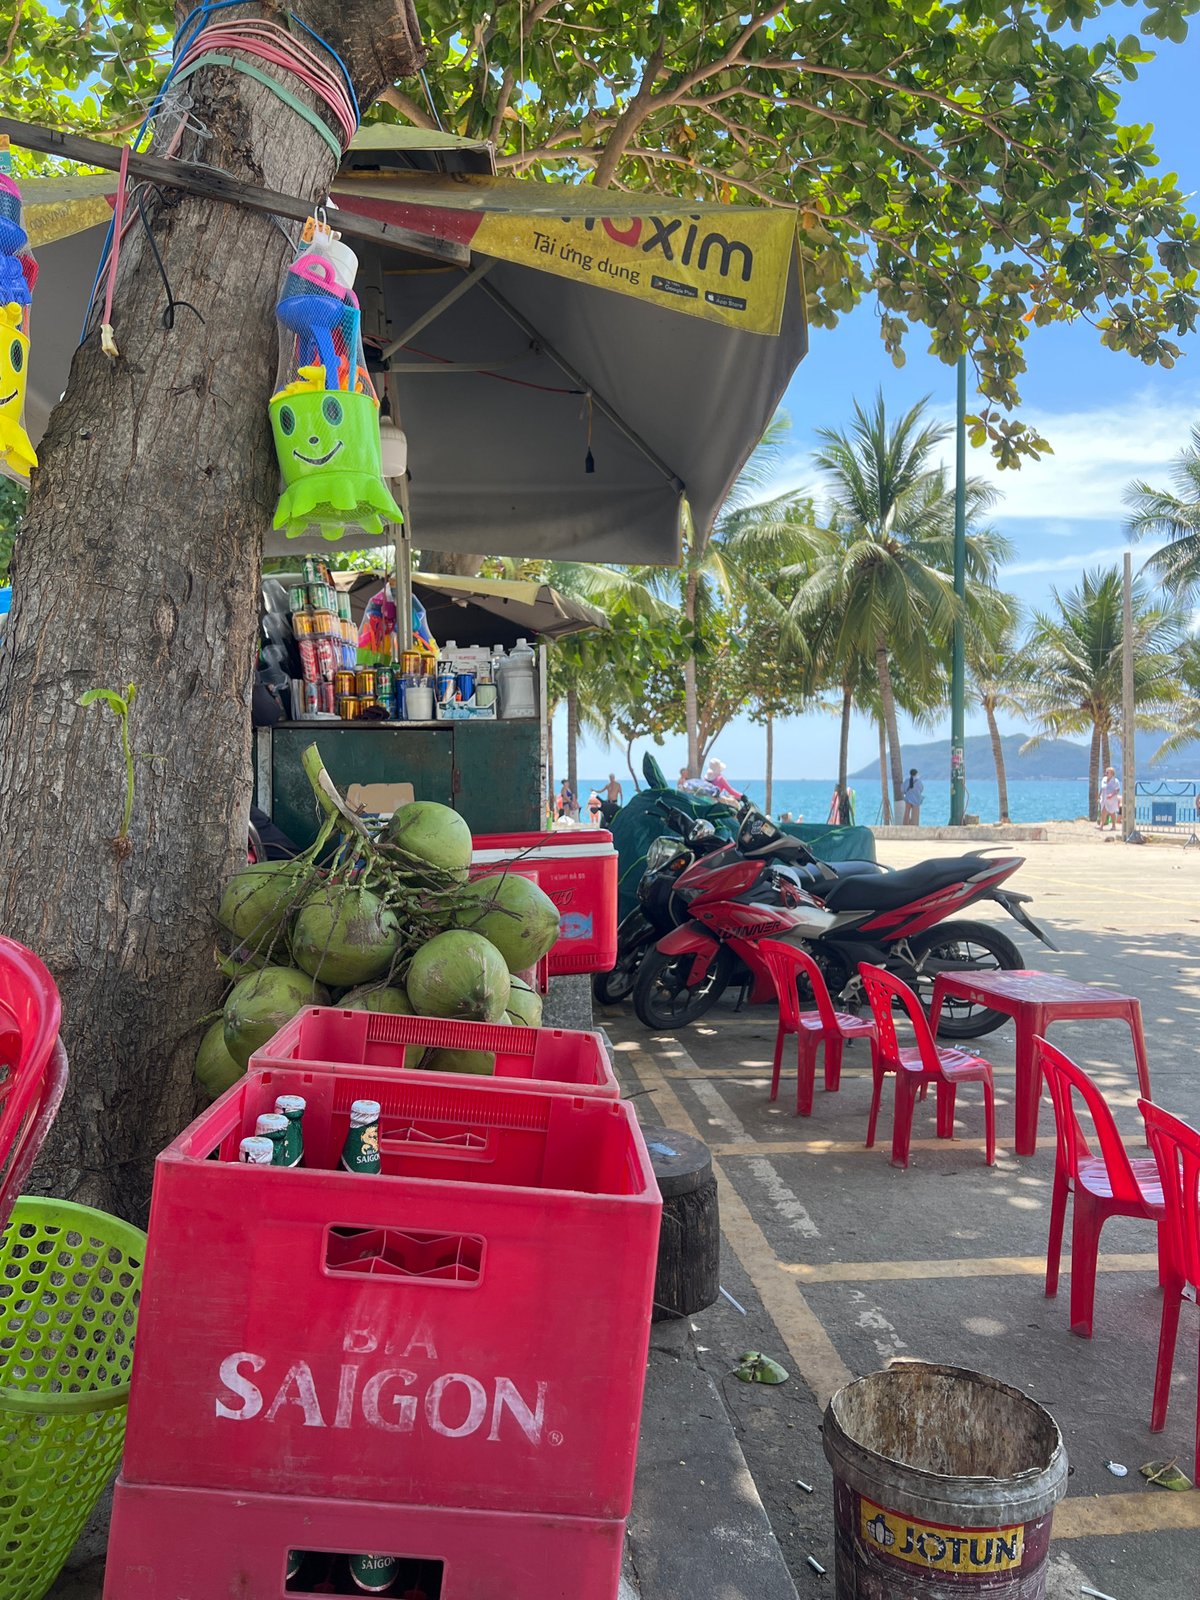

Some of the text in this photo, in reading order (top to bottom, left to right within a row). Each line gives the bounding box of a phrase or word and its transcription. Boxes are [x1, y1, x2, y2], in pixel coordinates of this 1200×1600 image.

[533, 231, 641, 285] Tải ứng dụng
[561, 214, 753, 282] axim
[664, 284, 684, 294] Google
[215, 1351, 549, 1447] SAIGON
[899, 1528, 1018, 1566] JOTUN
